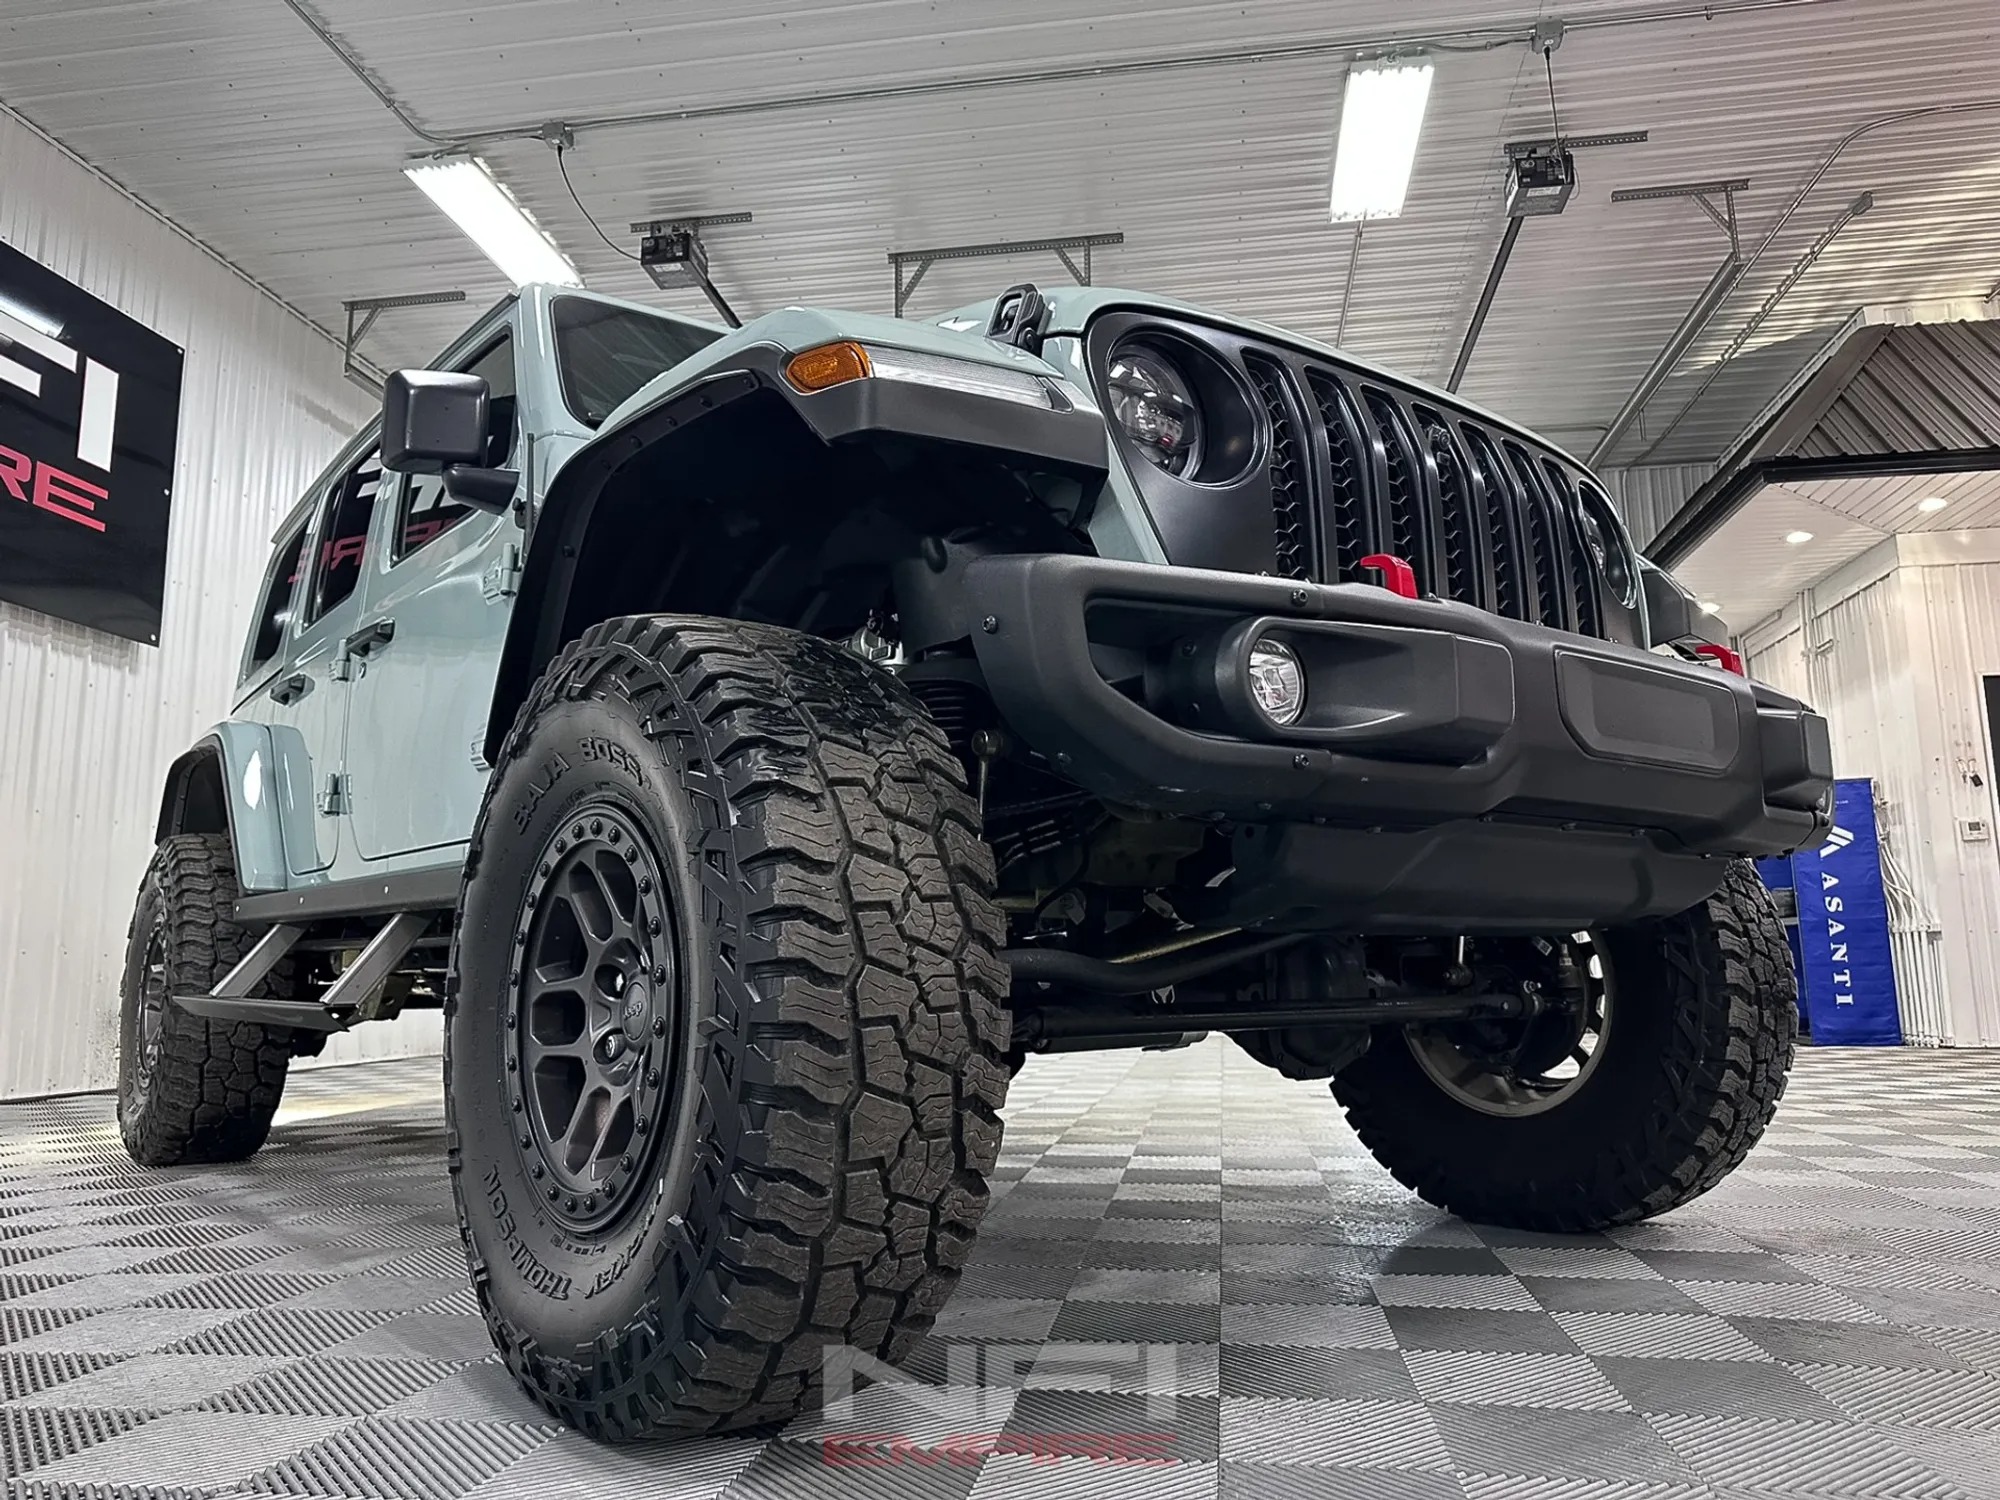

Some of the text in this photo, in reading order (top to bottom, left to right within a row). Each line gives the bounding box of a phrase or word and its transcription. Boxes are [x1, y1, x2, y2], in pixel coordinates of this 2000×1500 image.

[513, 751, 571, 836] BAJA
[1821, 872, 1854, 1005] ASANTI
[484, 1163, 573, 1301] THOMPSON
